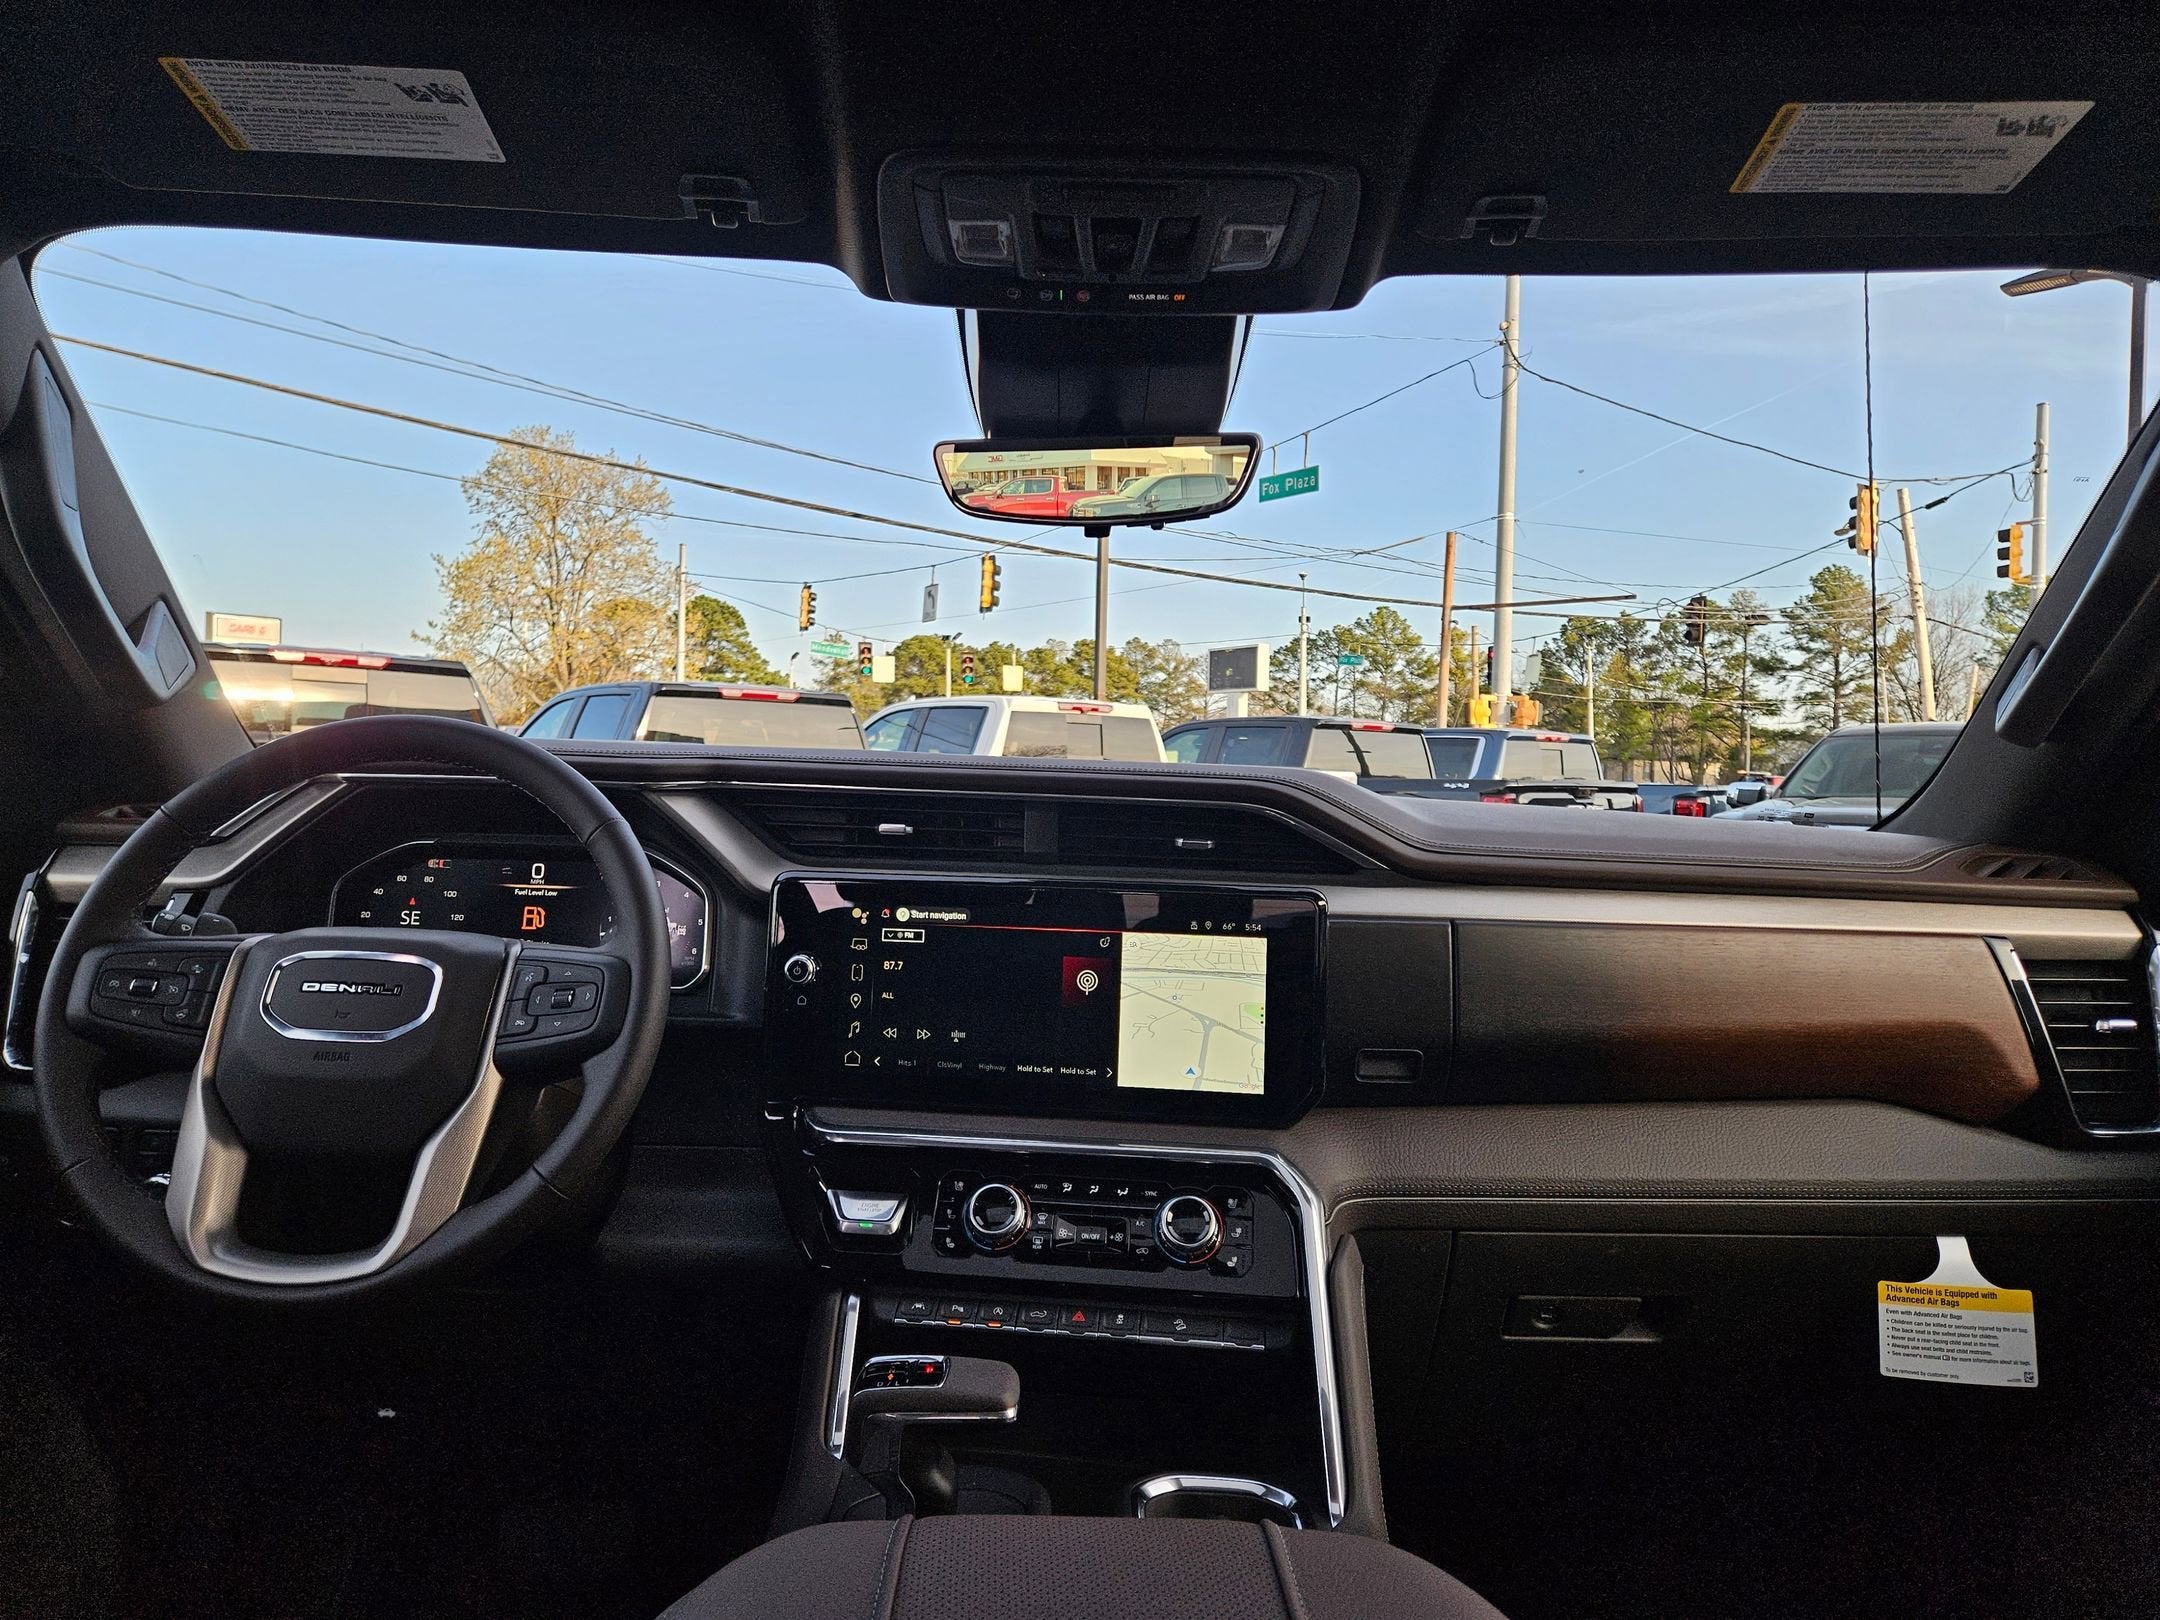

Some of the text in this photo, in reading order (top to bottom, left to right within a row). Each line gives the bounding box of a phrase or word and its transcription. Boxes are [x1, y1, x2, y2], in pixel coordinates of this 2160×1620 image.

[1262, 476, 1316, 496] Fox Plaza
[532, 863, 545, 879] 0
[400, 910, 421, 926] SE
[911, 910, 966, 921] Start navigation
[884, 960, 903, 970] 87.7
[302, 982, 403, 996] DENALI
[313, 1051, 351, 1062] AIRBAG
[978, 1064, 1006, 1072] Highway
[1886, 1284, 1902, 1293] This
[1905, 1286, 1933, 1295] Vehicle
[1944, 1289, 1979, 1300] Equipped
[1981, 1292, 1998, 1300] with
[1886, 1294, 1925, 1304] Advanced
[1940, 1298, 1960, 1308] Bags
